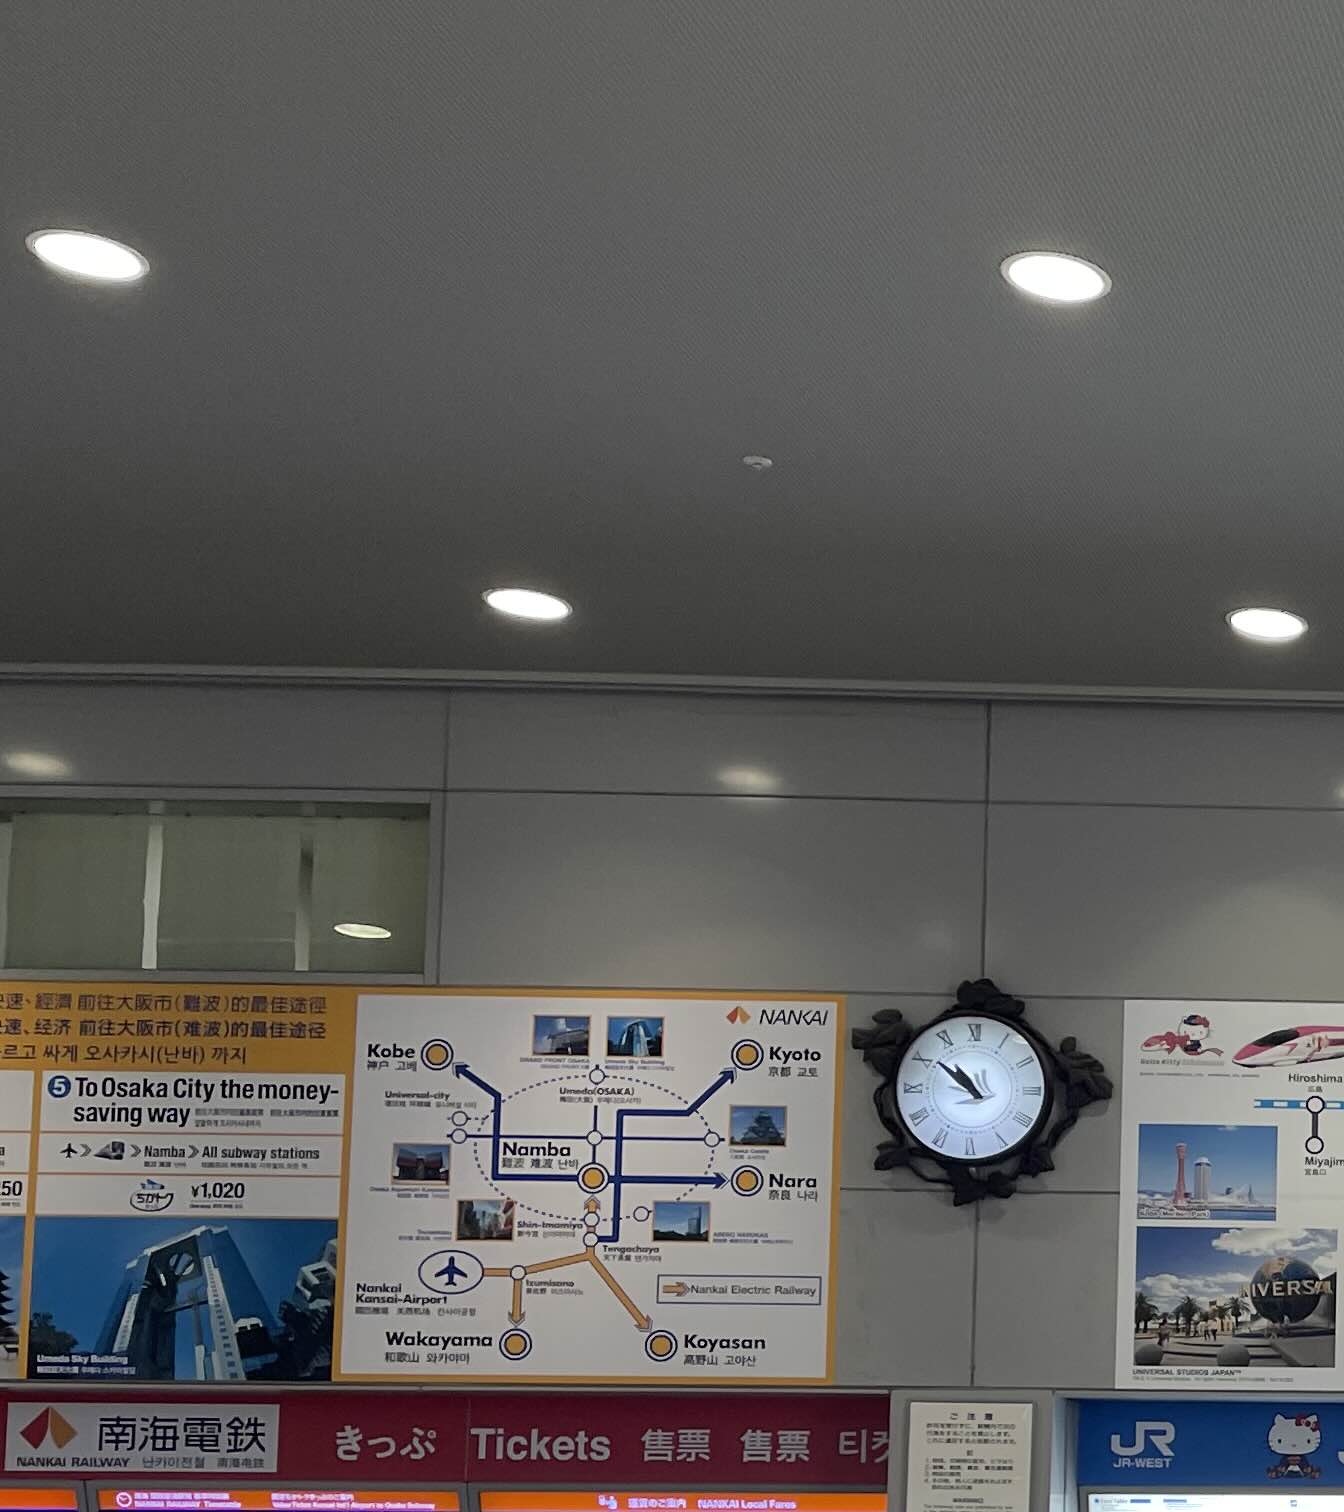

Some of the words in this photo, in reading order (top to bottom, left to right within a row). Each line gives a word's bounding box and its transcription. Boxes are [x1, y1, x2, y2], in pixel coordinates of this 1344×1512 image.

[759, 1009, 829, 1026] NANKAI
[367, 1044, 415, 1058] Kobe
[769, 1047, 822, 1064] Kyoto
[1288, 1073, 1343, 1084] Hiroshima
[75, 1077, 98, 1098] To
[101, 1077, 168, 1099] Osaka
[173, 1078, 214, 1103] City
[219, 1080, 254, 1099] the
[73, 1103, 143, 1127] saving
[147, 1108, 190, 1128] way
[144, 1145, 185, 1159] Namba
[202, 1145, 217, 1159] All
[221, 1146, 267, 1161] subway
[270, 1147, 320, 1160] stations
[503, 1142, 571, 1157] Namba
[769, 1174, 817, 1188] Nara
[191, 1182, 245, 1200] ¥1,020
[357, 1283, 402, 1293] Nankai
[356, 1295, 447, 1306] Kansai-Airport
[385, 1332, 493, 1350] Wakayama
[684, 1335, 766, 1352] Koyasan
[98, 1416, 266, 1453] 南海電鉄
[1111, 1421, 1175, 1457] JR
[336, 1425, 437, 1461] きっぷ
[470, 1427, 611, 1462] Tickets
[641, 1429, 710, 1463] 售票
[741, 1429, 811, 1463] 售票
[17, 1456, 66, 1467] NANKAI
[71, 1457, 130, 1468] RAILWAY
[1113, 1458, 1172, 1468] JR-WEST
